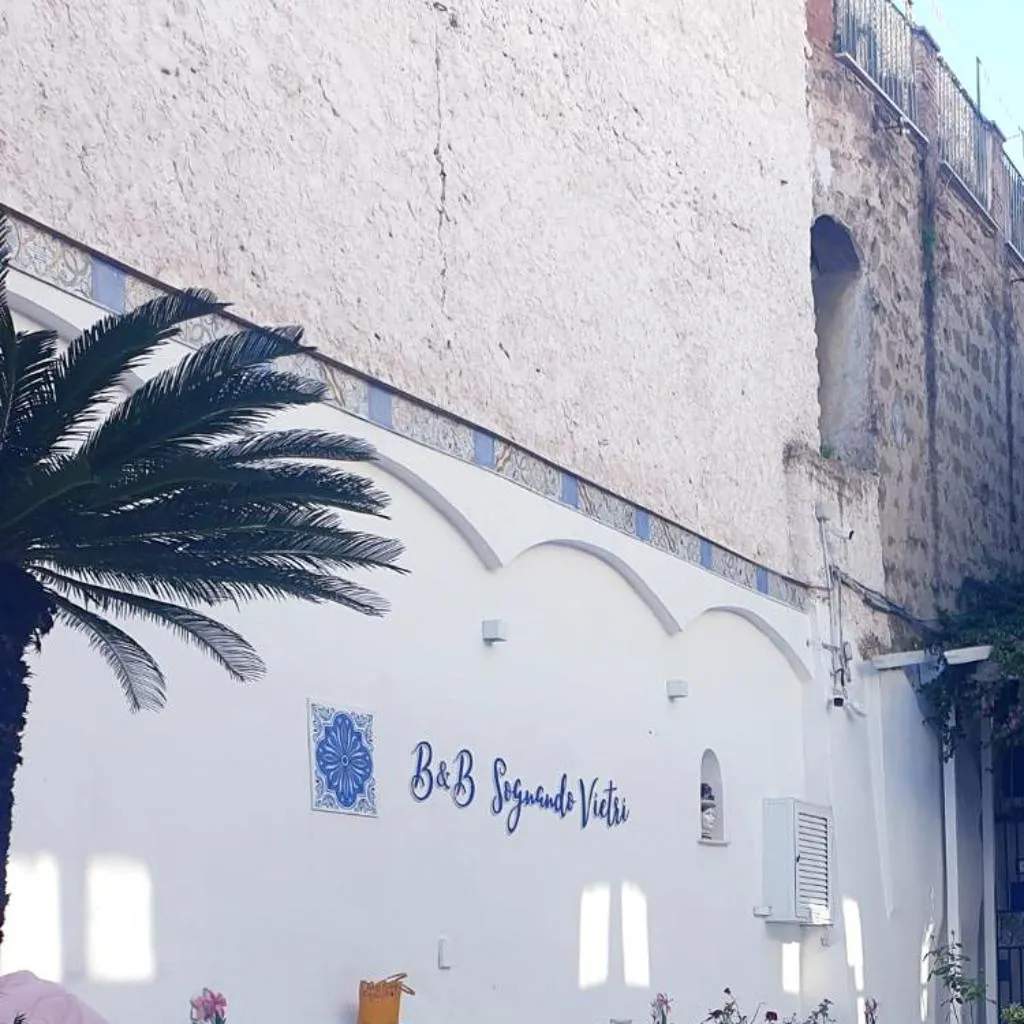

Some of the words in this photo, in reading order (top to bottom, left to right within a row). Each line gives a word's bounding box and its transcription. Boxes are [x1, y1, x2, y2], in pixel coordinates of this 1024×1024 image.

[411, 740, 475, 808] B&B
[491, 757, 575, 834] Sognando
[579, 777, 629, 828] Vietri
